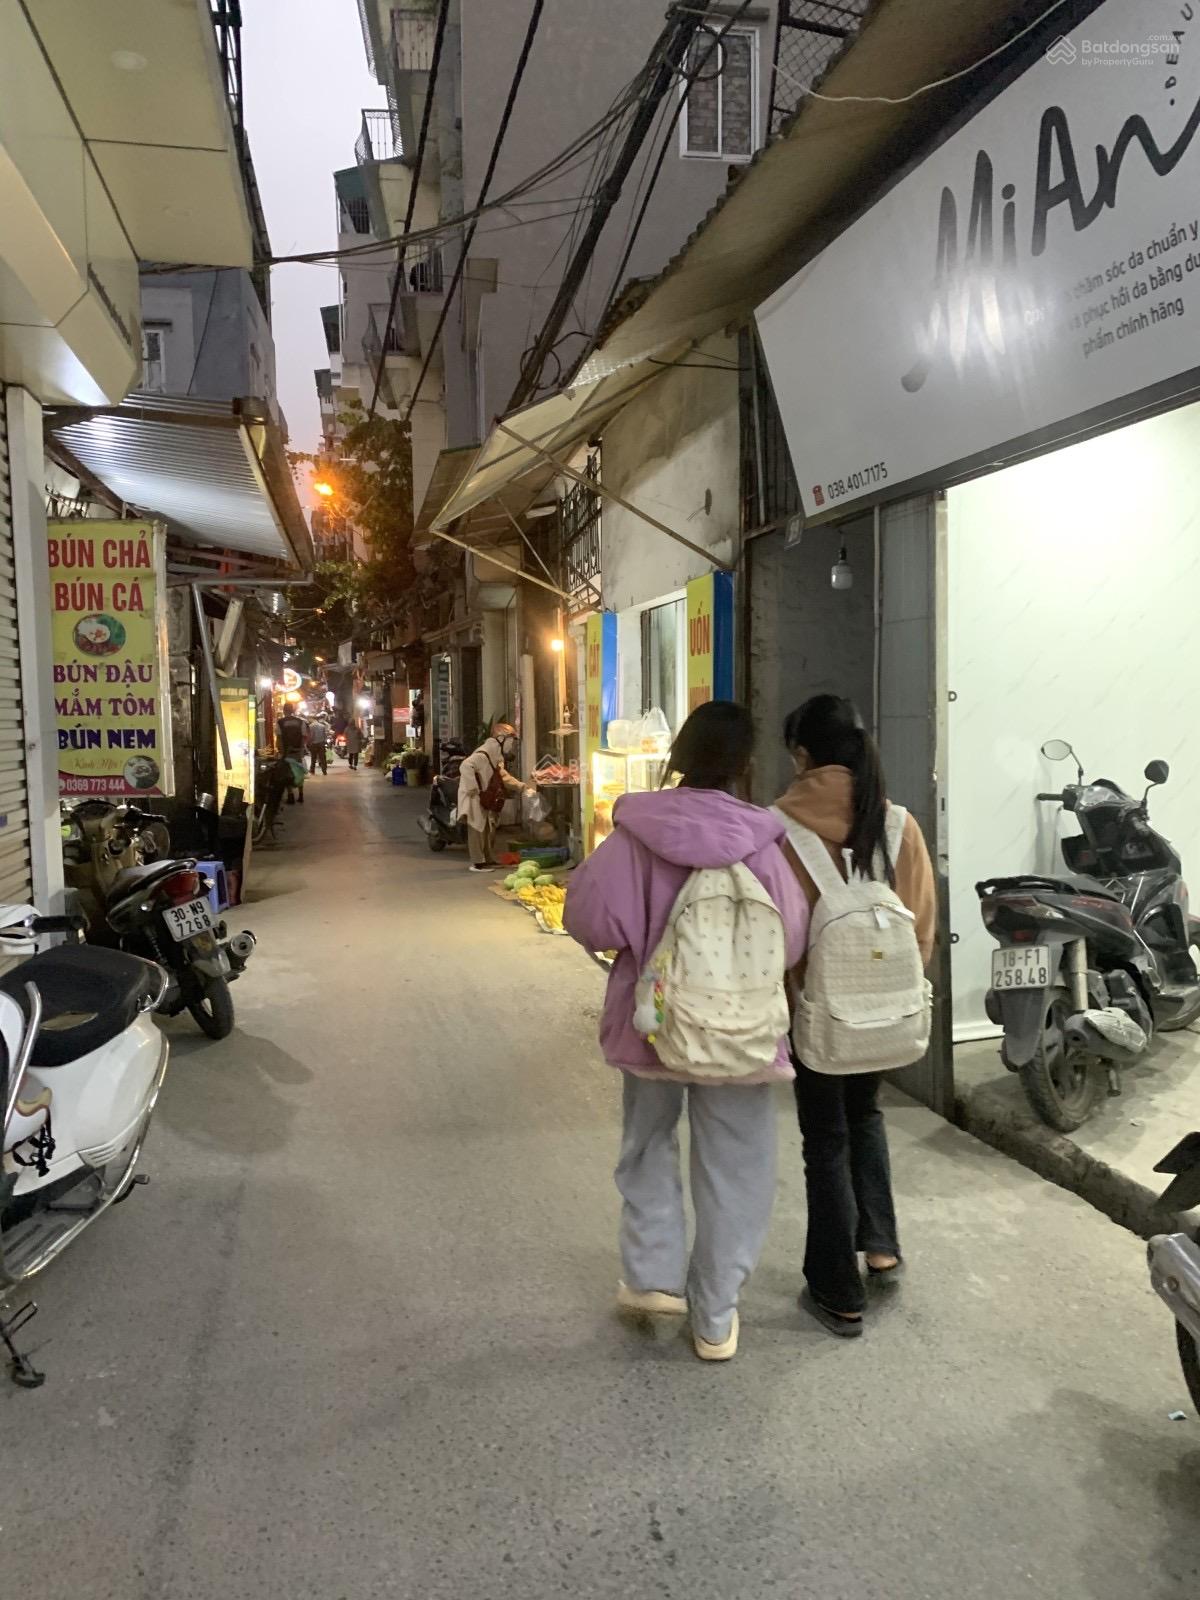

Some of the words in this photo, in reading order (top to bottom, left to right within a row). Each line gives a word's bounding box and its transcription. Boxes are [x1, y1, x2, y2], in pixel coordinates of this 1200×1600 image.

[1105, 260, 1126, 283] sóc
[1128, 251, 1144, 270] da
[1146, 222, 1188, 260] chuẩn
[1132, 281, 1148, 299] da
[1149, 266, 1183, 292] bằng
[1116, 313, 1149, 341] chính
[1150, 297, 1185, 325] hãng
[827, 461, 888, 499] 038.401.7175
[48, 532, 95, 568] BÚN
[102, 529, 151, 568] CHẢ
[55, 576, 104, 611] BÚN
[112, 576, 144, 611] CÁ
[690, 600, 710, 657] UỐN
[53, 659, 98, 683] BÚN
[105, 659, 153, 689] ĐẬU
[108, 692, 155, 716] TÔM
[57, 723, 102, 750] BÚN
[107, 729, 156, 749] NEM
[91, 778, 107, 791] 773
[109, 778, 125, 791] 444
[176, 914, 211, 937] 7268
[1002, 948, 1040, 968] 18-F1
[995, 967, 1047, 988] 258.48
